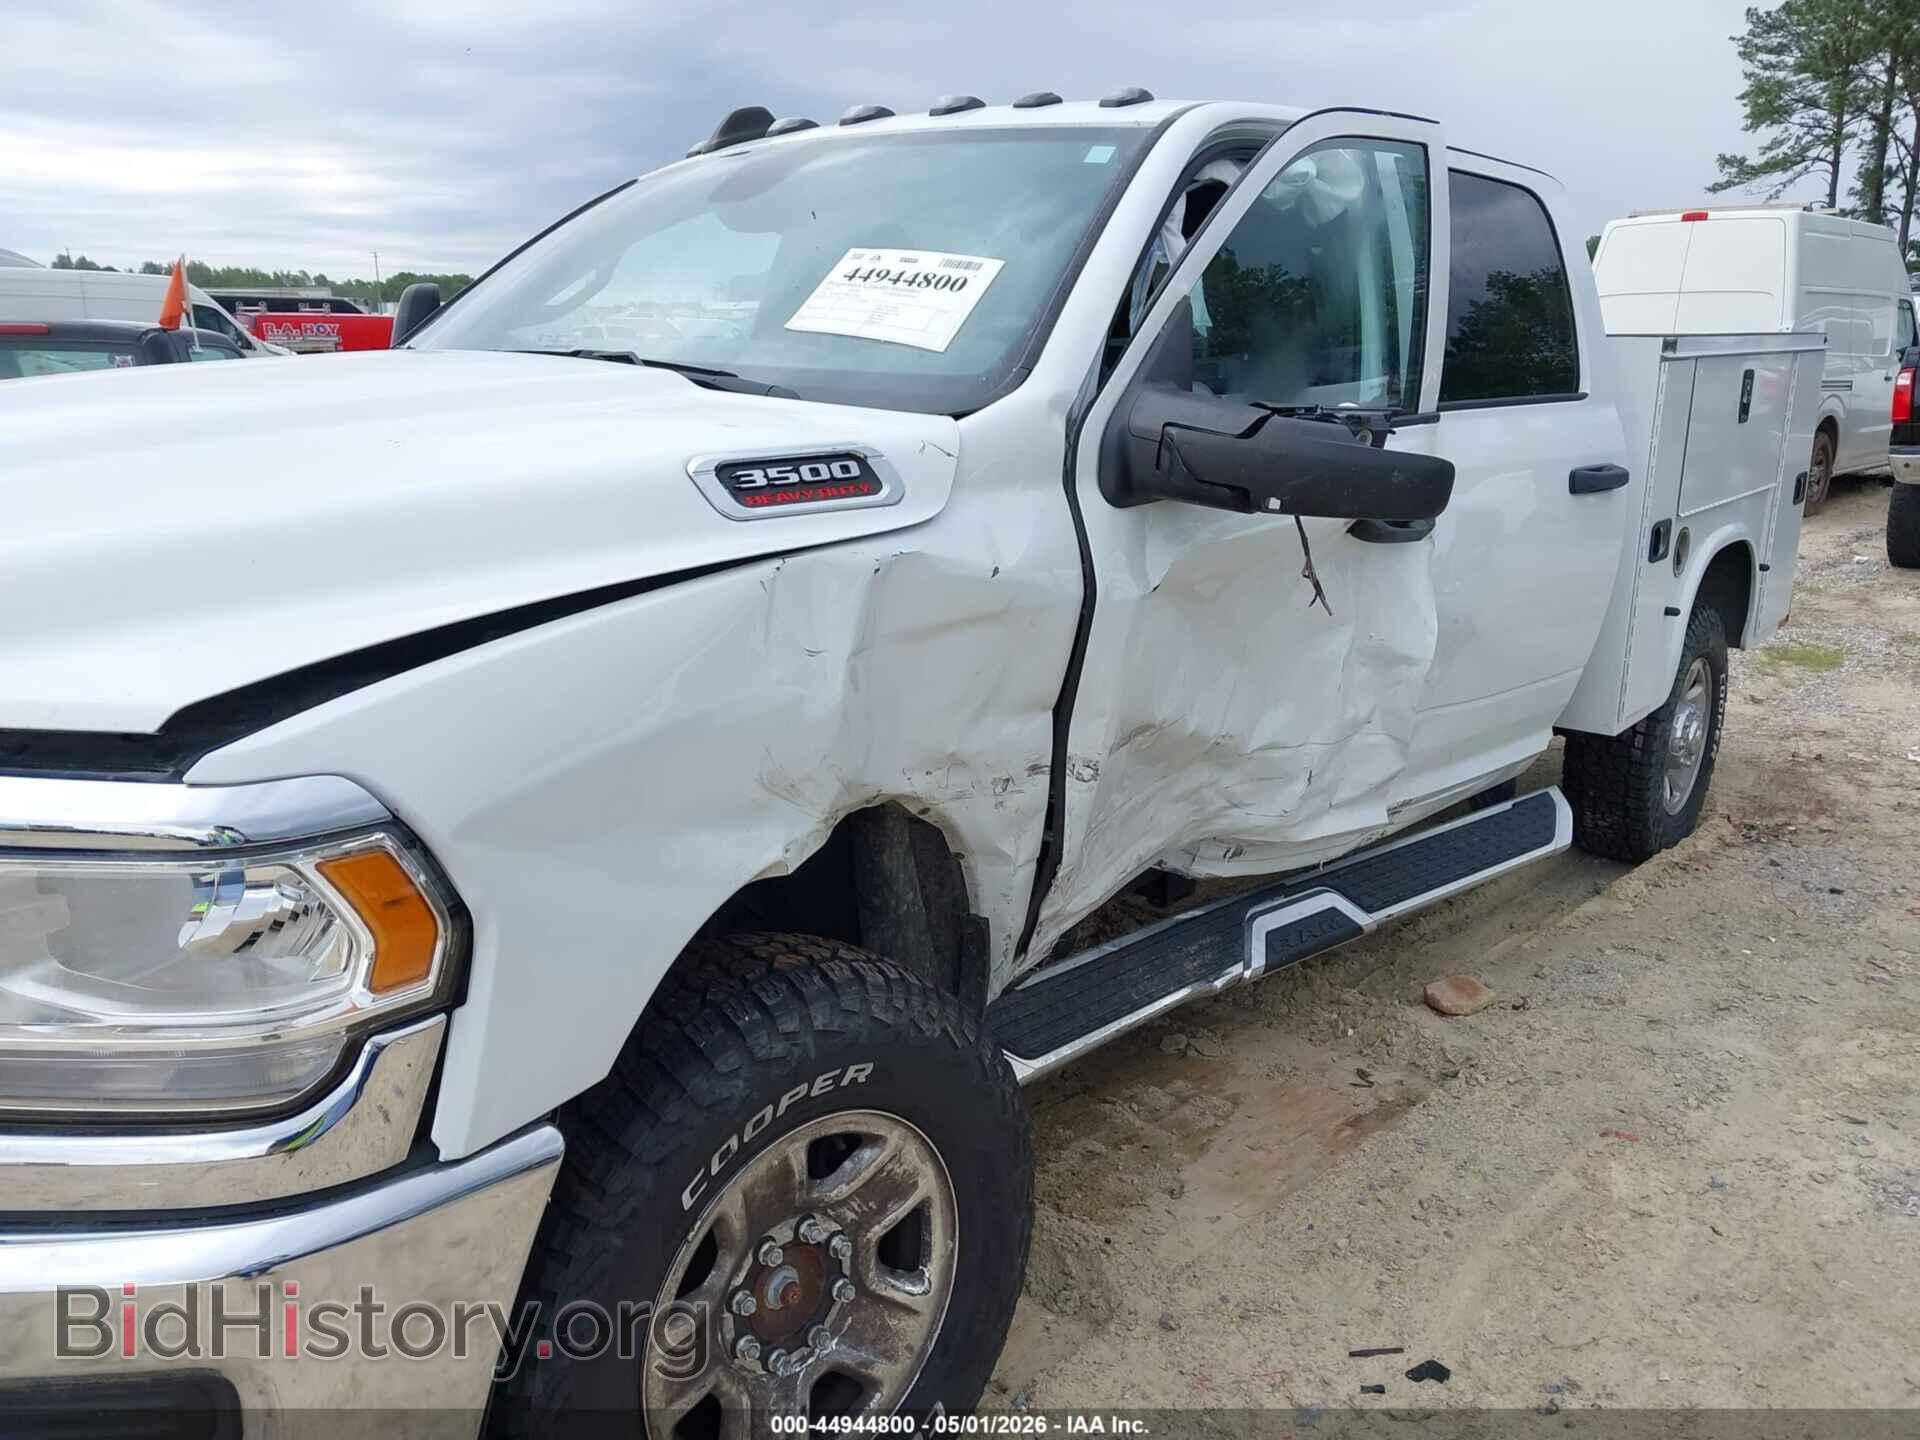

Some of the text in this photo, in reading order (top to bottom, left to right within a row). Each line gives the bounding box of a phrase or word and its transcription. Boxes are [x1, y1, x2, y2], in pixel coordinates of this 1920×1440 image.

[843, 266, 969, 293] 44944800
[301, 322, 340, 337] HOY
[732, 461, 861, 488] 3500
[745, 483, 872, 506] HEAVY DUTY
[681, 1062, 875, 1212] COOPER
